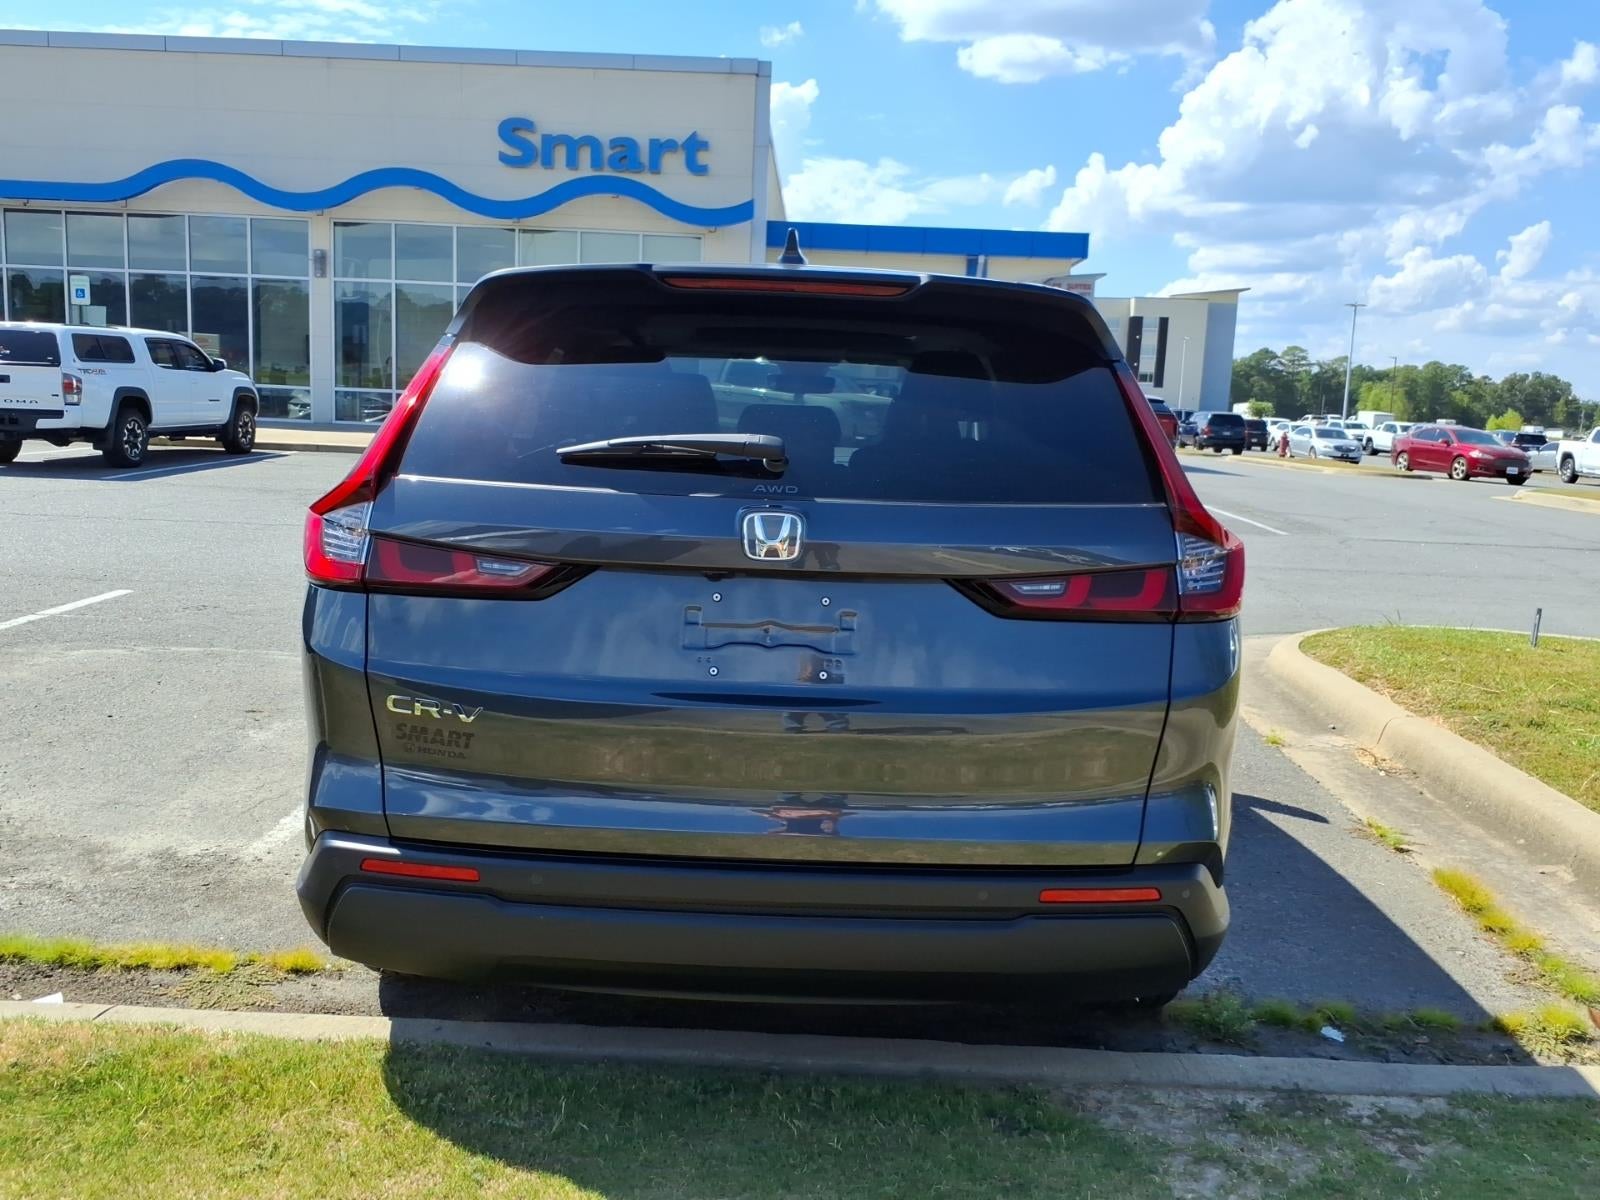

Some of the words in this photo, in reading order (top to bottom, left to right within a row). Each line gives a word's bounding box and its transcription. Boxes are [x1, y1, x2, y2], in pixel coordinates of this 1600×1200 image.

[498, 117, 710, 176] Smart
[753, 484, 798, 494] AWD
[386, 694, 484, 723] CR-V
[395, 722, 475, 749] SMART
[418, 745, 467, 759] HONDA
